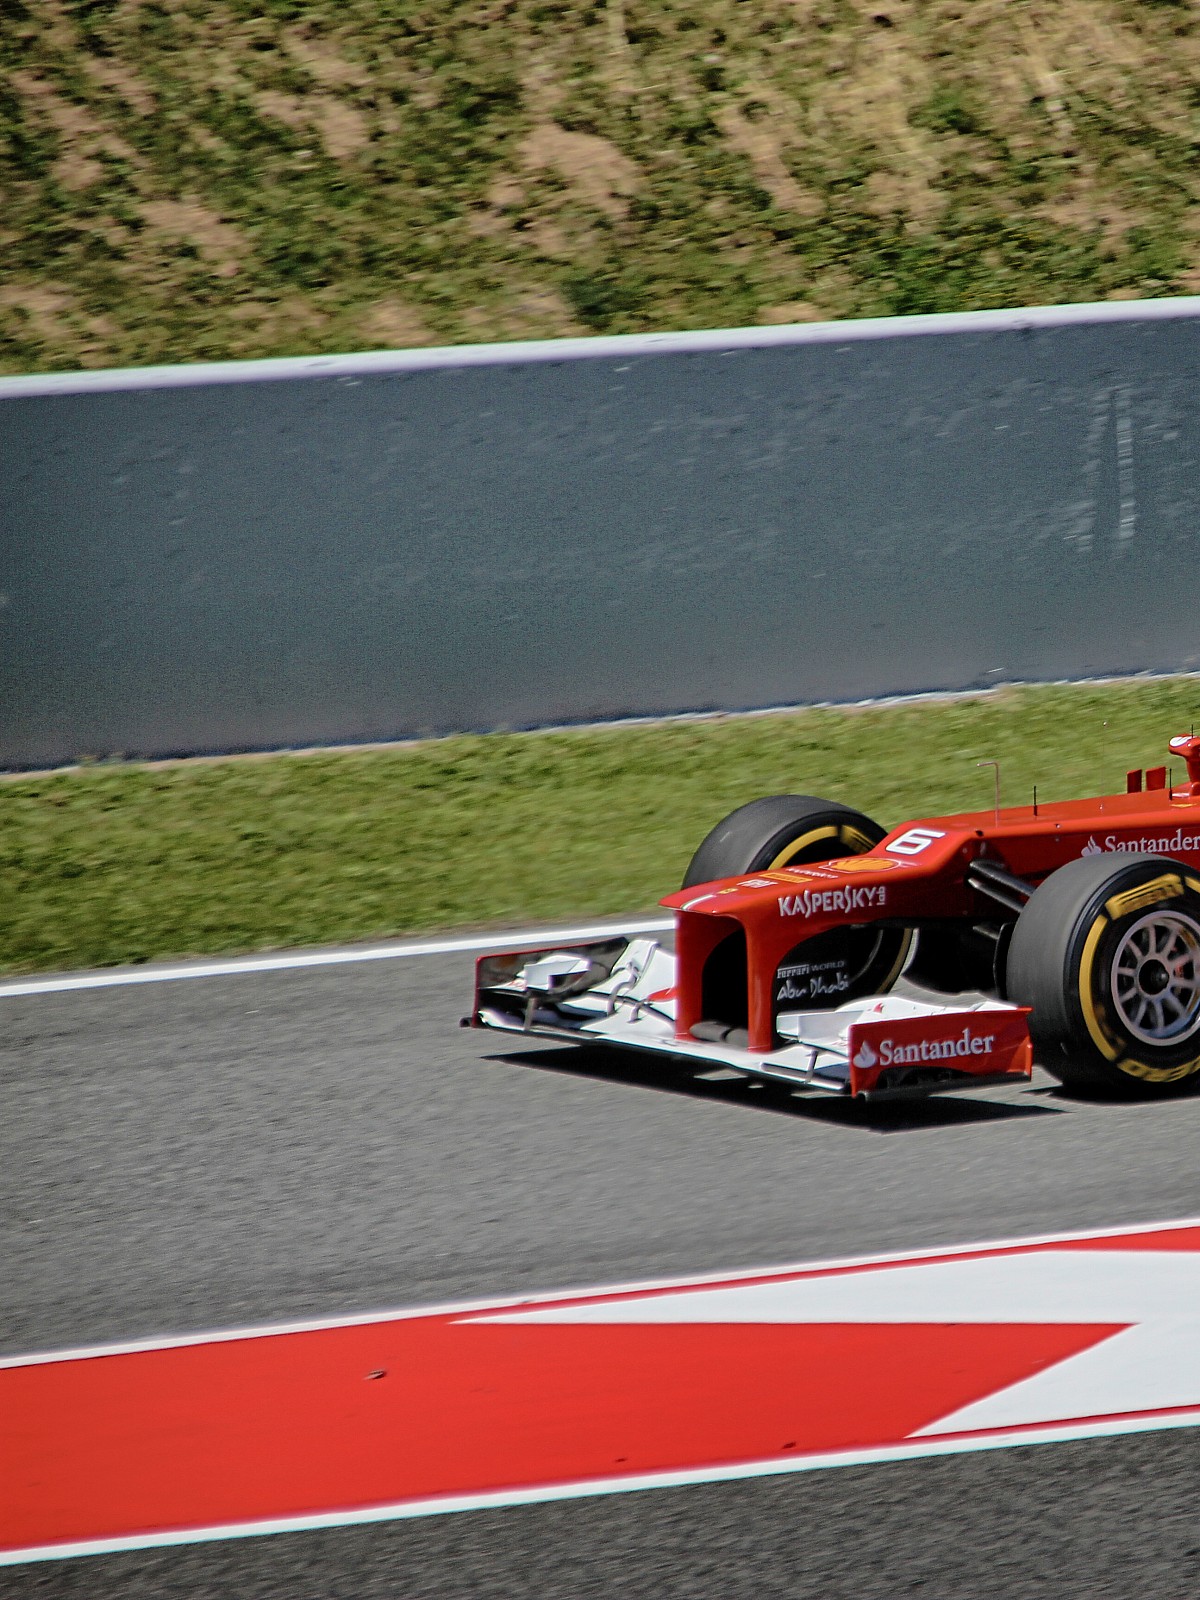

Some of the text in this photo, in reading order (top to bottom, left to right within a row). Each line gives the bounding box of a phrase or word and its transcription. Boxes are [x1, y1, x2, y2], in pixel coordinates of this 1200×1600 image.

[886, 828, 946, 855] 6
[1104, 828, 1200, 853] Santander
[778, 885, 877, 918] KASPERSKY
[811, 961, 845, 972] WORLD
[777, 972, 849, 1000] Abu Dhabi
[879, 1027, 994, 1066] Santander
